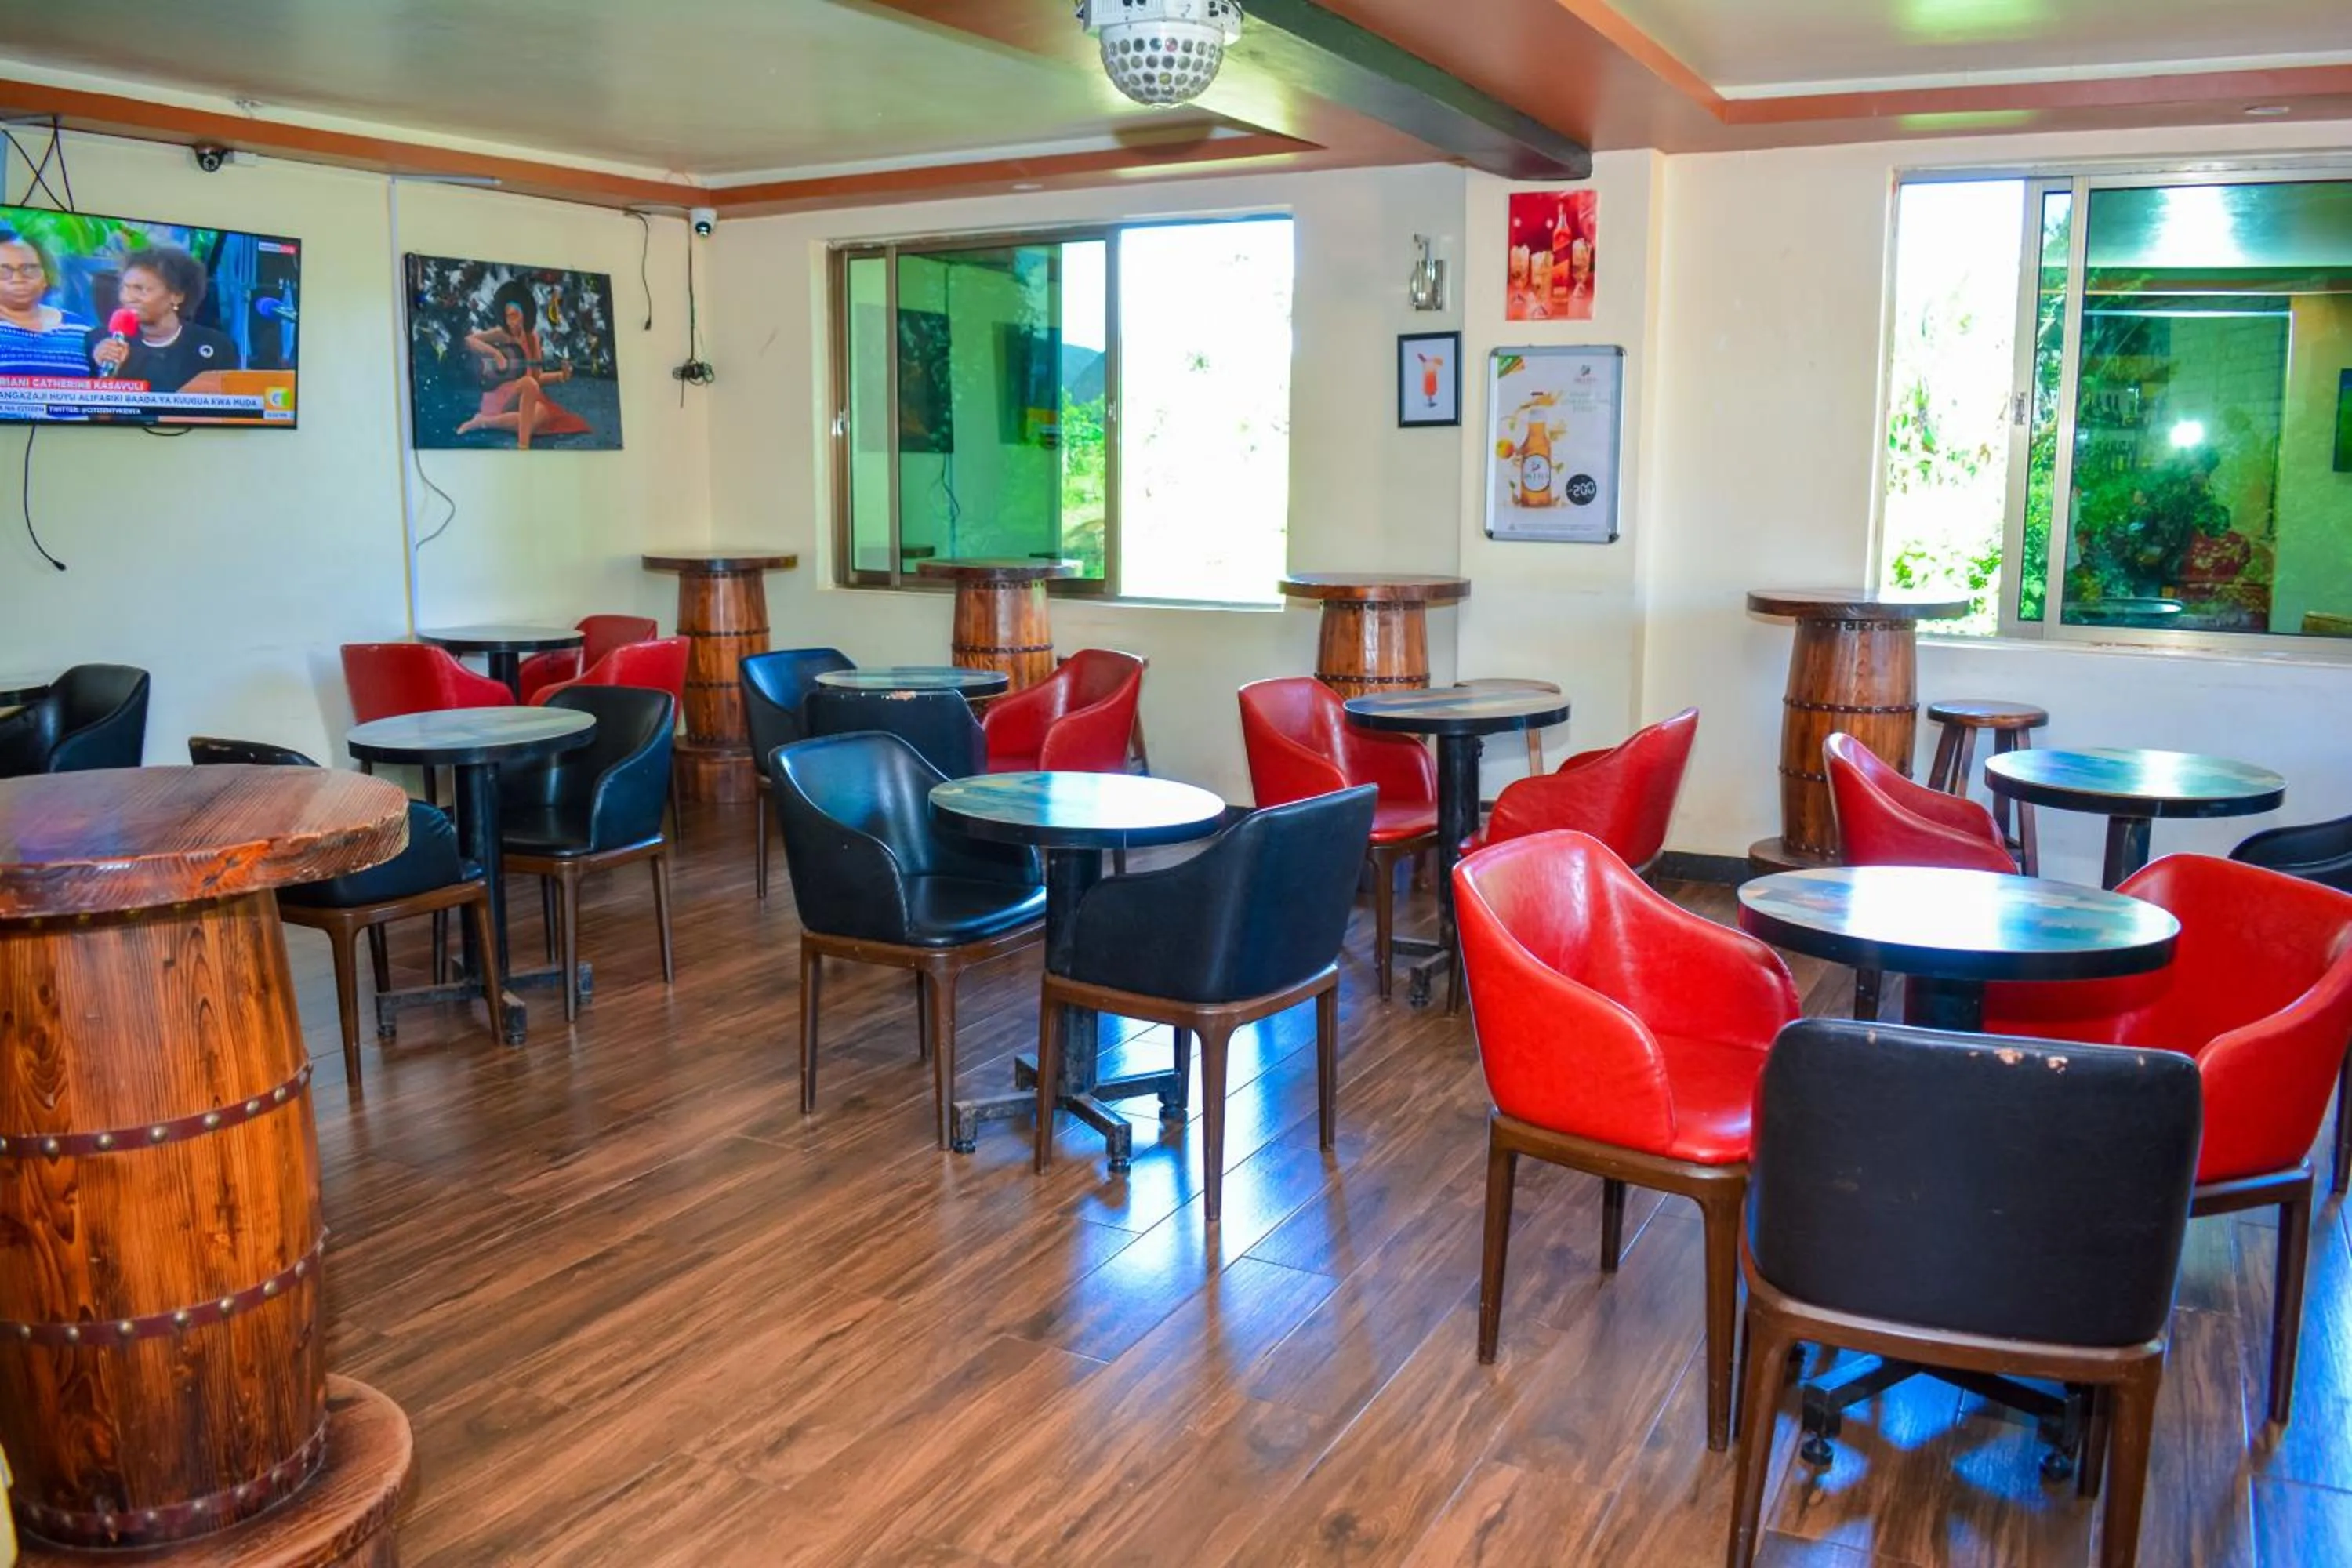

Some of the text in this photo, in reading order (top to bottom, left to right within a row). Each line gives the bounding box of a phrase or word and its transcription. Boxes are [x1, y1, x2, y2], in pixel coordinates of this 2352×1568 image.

[32, 379, 91, 389] CATHERINE
[93, 381, 143, 390] KASAVULI
[78, 394, 123, 402] ALIFARIKI
[125, 394, 157, 404] BAADA
[211, 397, 231, 406] KWA
[233, 398, 257, 407] MUDA
